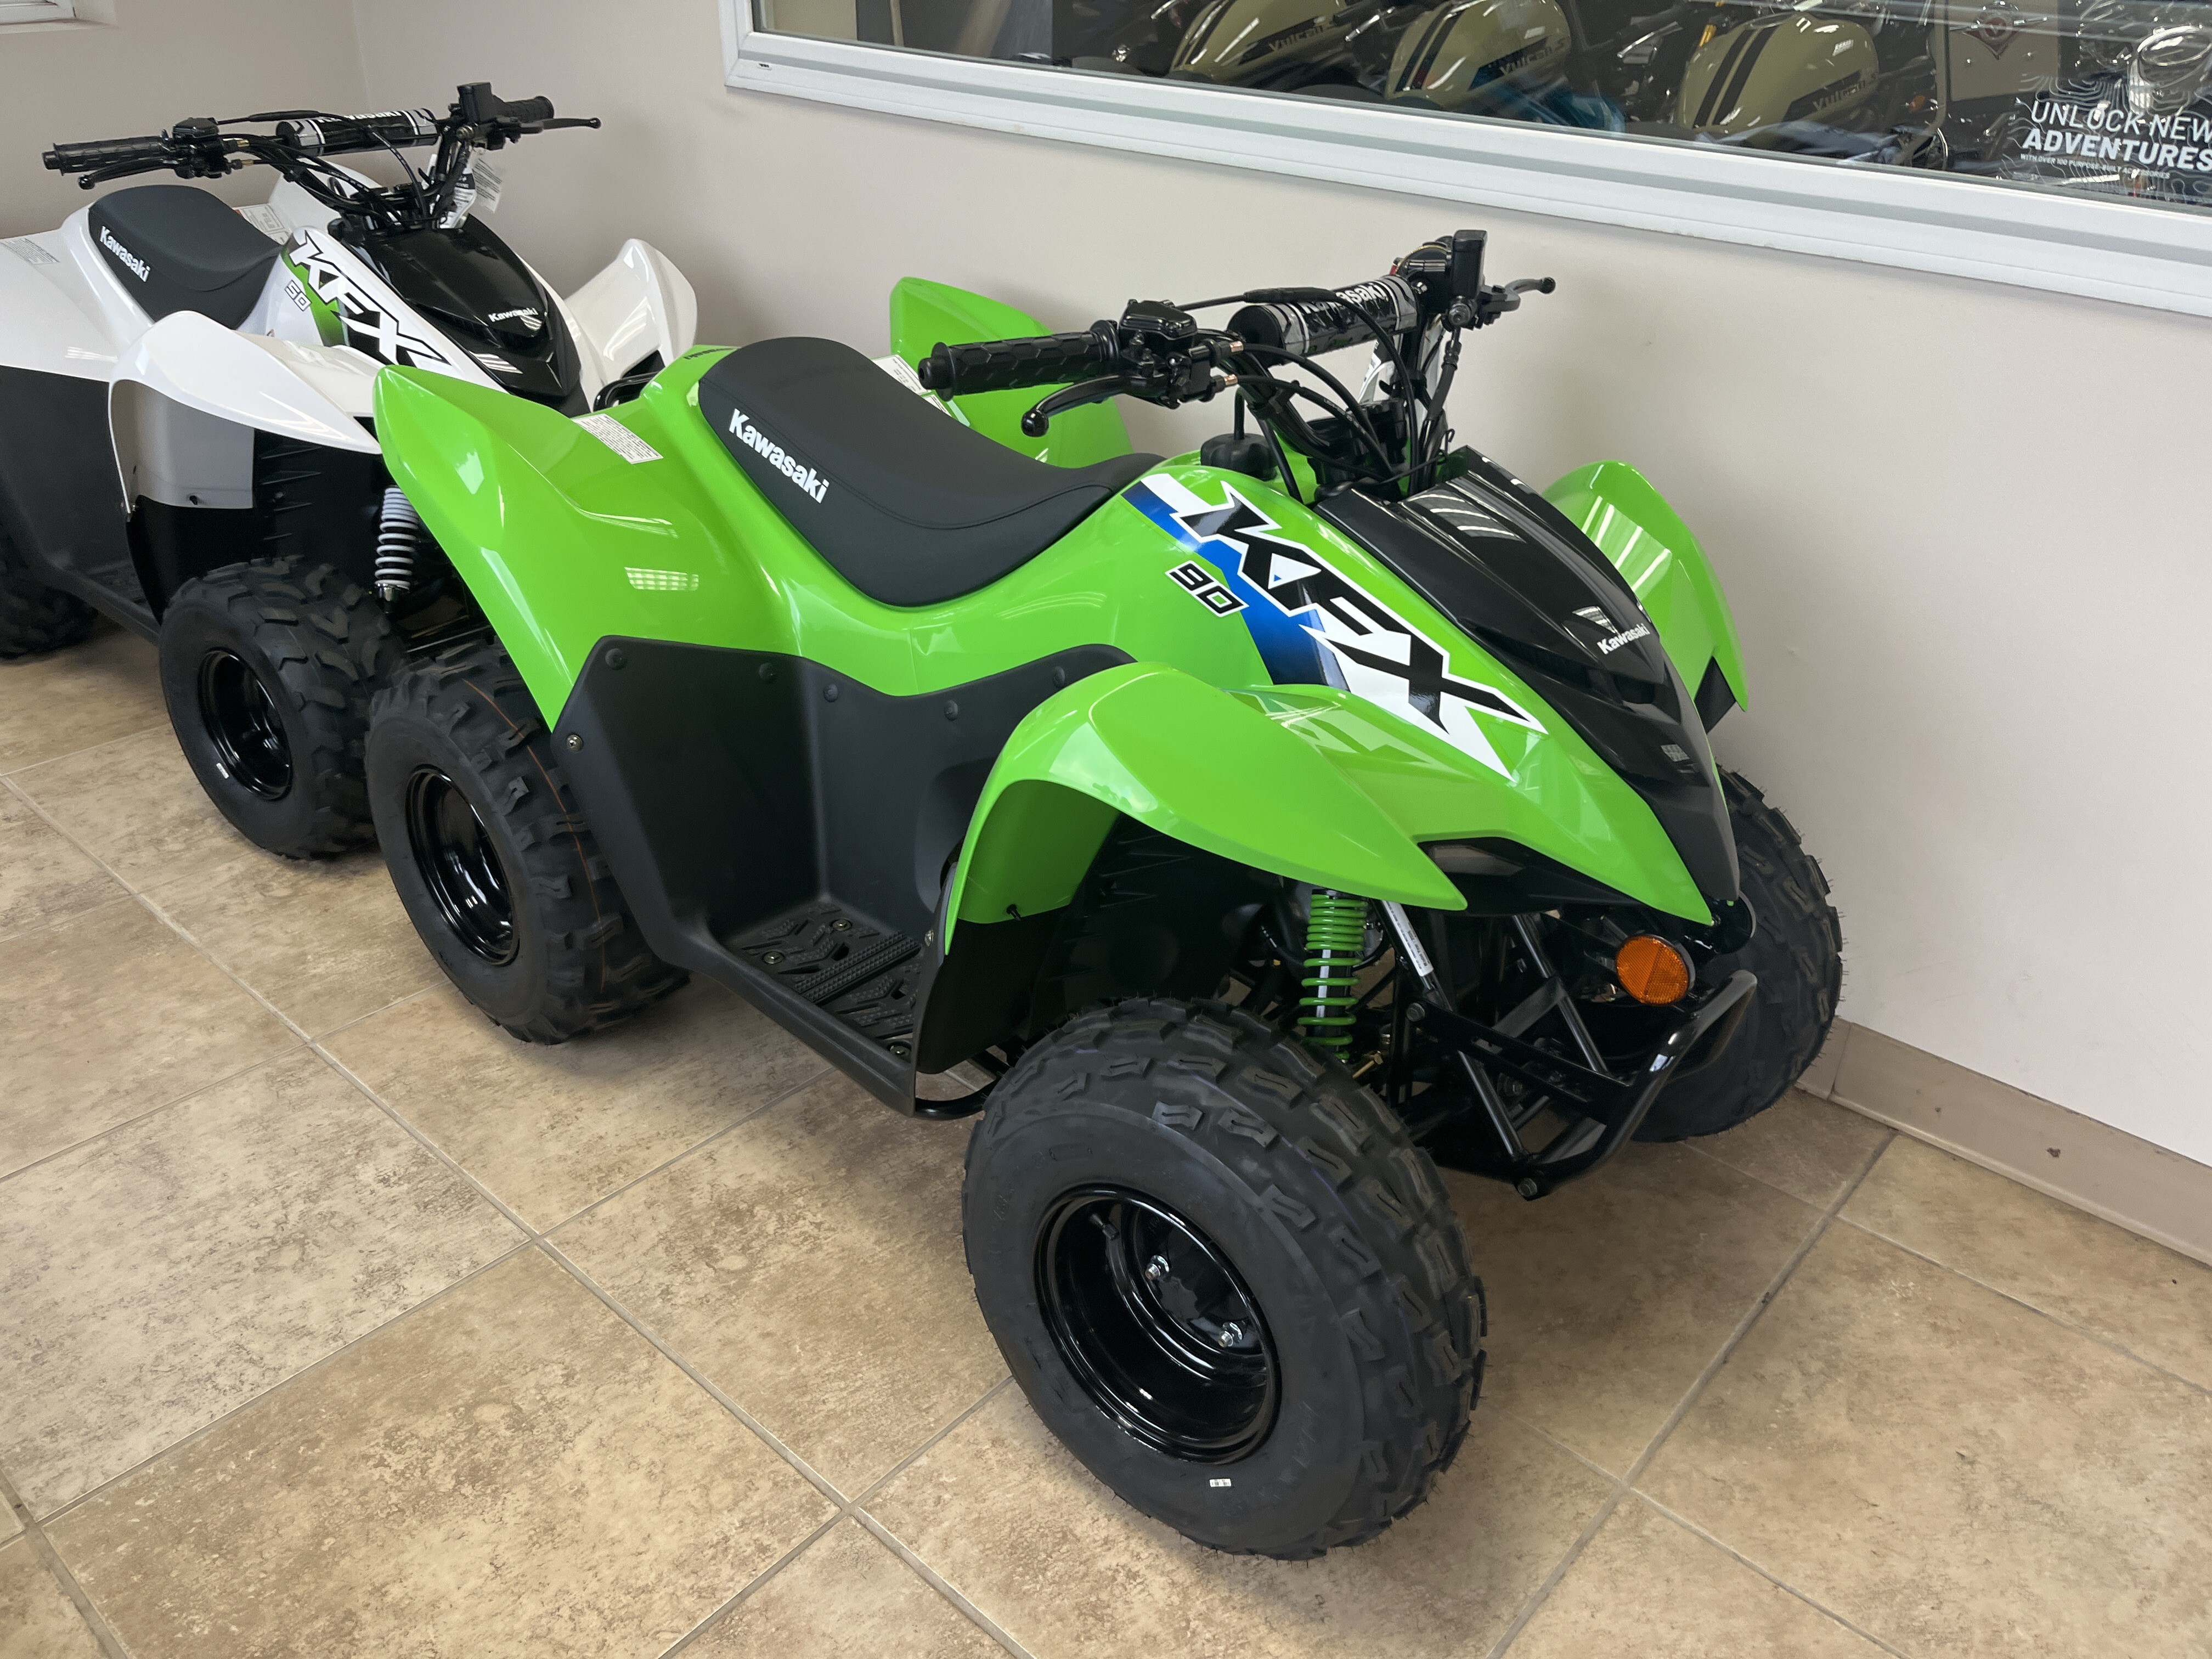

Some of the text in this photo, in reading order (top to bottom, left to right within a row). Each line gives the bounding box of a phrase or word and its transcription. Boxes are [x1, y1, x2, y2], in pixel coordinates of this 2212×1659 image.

[2031, 100, 2145, 135] UNLOCK
[2022, 128, 2212, 172] ADVENTURES
[100, 225, 151, 283] Kawasaki
[284, 279, 312, 312] 50
[287, 232, 453, 368] KFX
[488, 307, 539, 323] Kawasaki
[729, 408, 830, 504] Kawasaki
[1166, 561, 1247, 616] 90
[1174, 487, 1543, 740] KFX
[1596, 623, 1650, 654] Kawasaki
